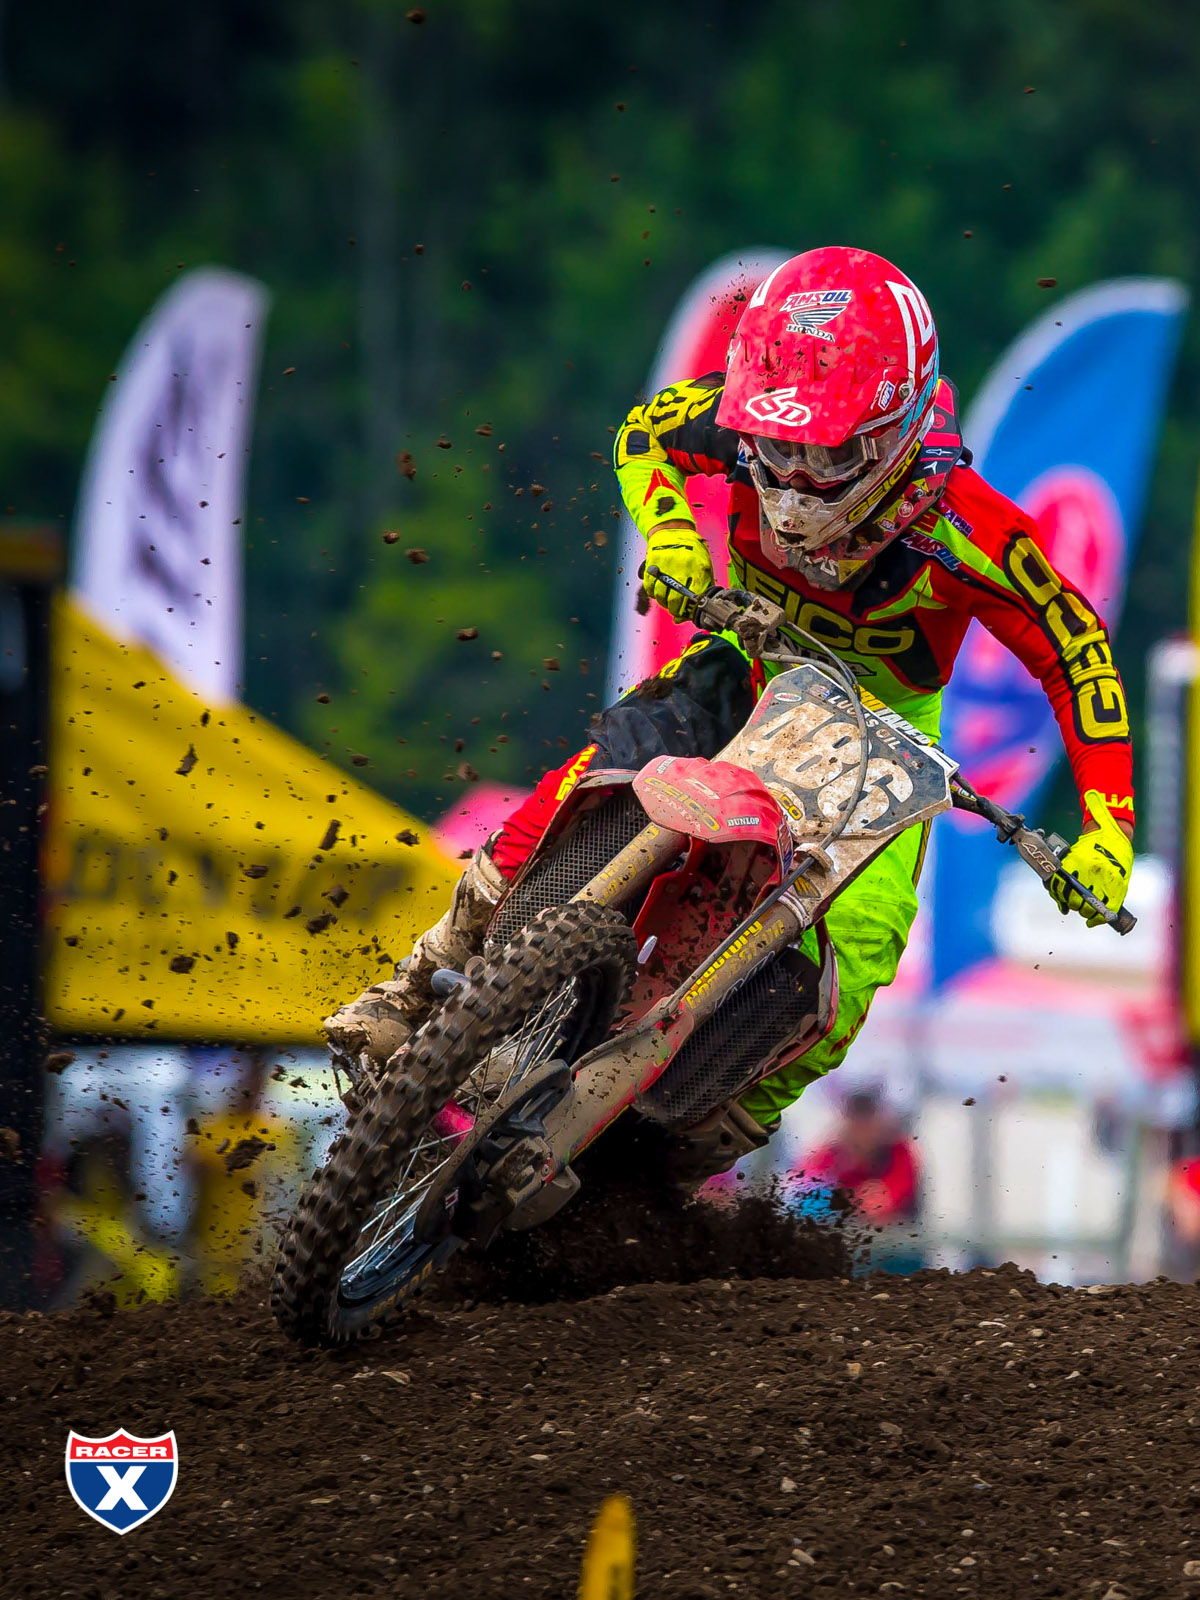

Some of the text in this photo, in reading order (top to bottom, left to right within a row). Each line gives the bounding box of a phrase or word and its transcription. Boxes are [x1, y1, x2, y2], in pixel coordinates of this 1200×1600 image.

[780, 290, 852, 312] AMSOIL
[787, 325, 835, 342] HONDA
[745, 387, 812, 427] 6D
[847, 440, 922, 523] GEICO
[1009, 536, 1131, 740] GEICO
[875, 728, 901, 750] OIL
[645, 777, 722, 832] GEICO
[727, 816, 760, 827] DUNLOP
[1022, 842, 1057, 873] ARC
